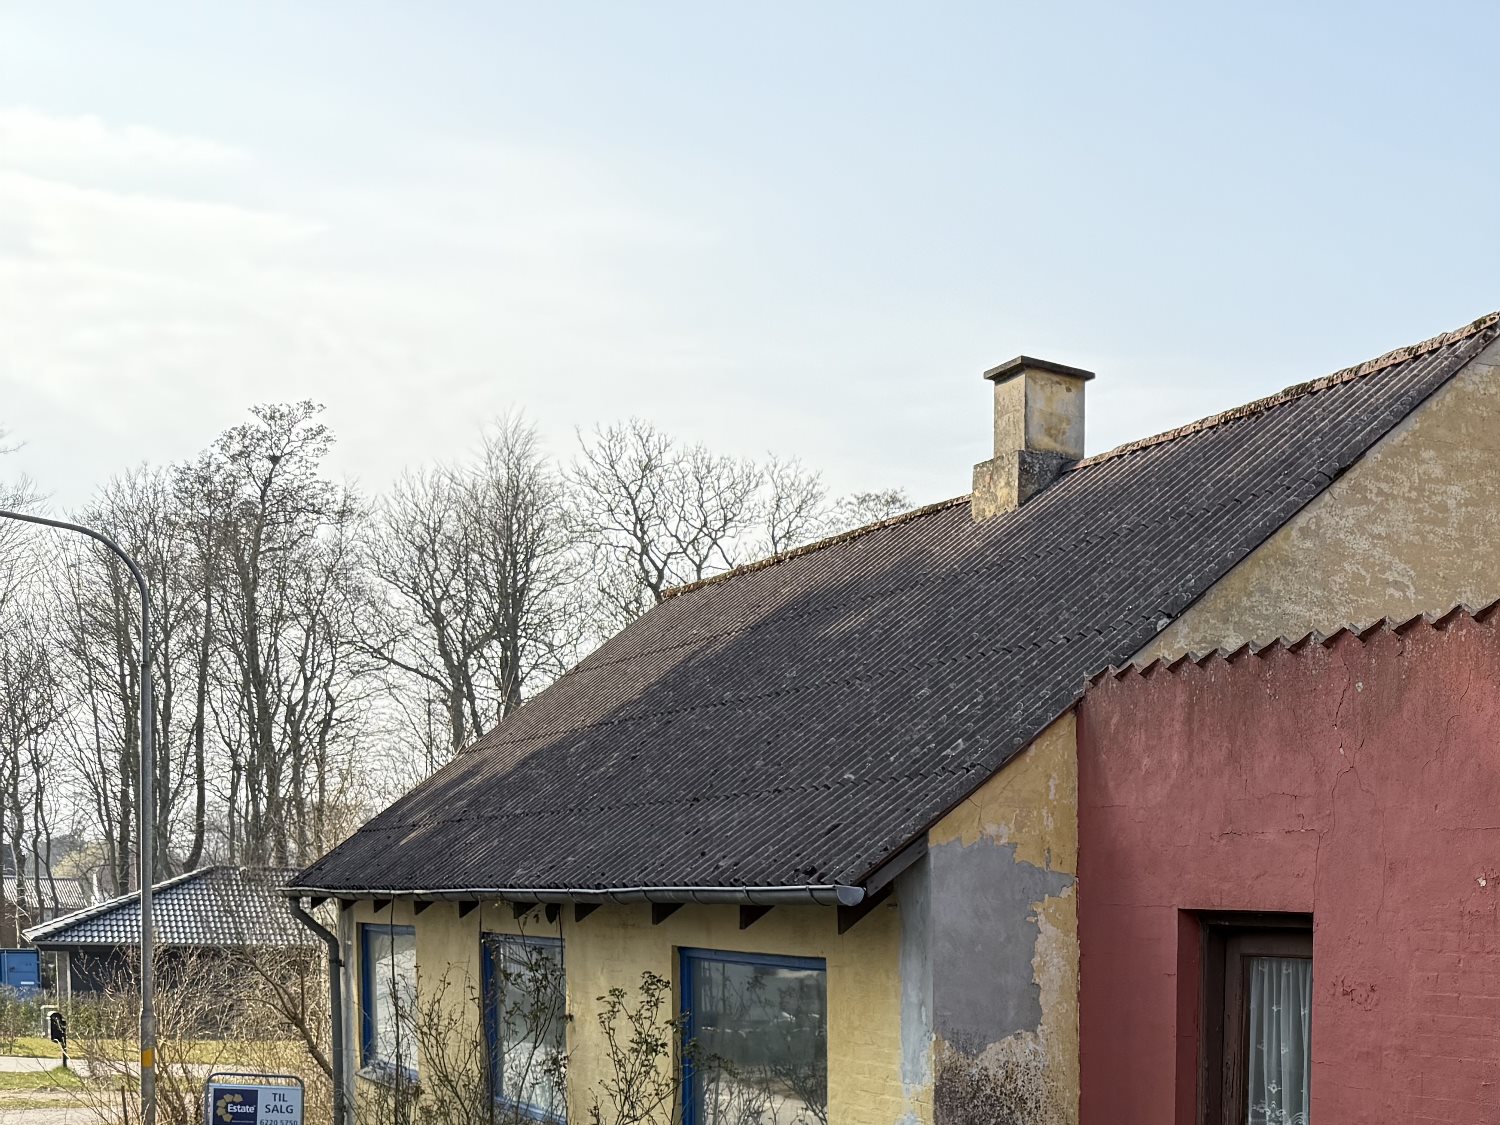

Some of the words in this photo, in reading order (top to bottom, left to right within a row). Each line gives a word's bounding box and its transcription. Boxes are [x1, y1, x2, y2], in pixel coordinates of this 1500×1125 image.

[272, 1093, 288, 1102] TIL
[227, 1104, 255, 1113] Estate
[265, 1104, 294, 1114] SALG
